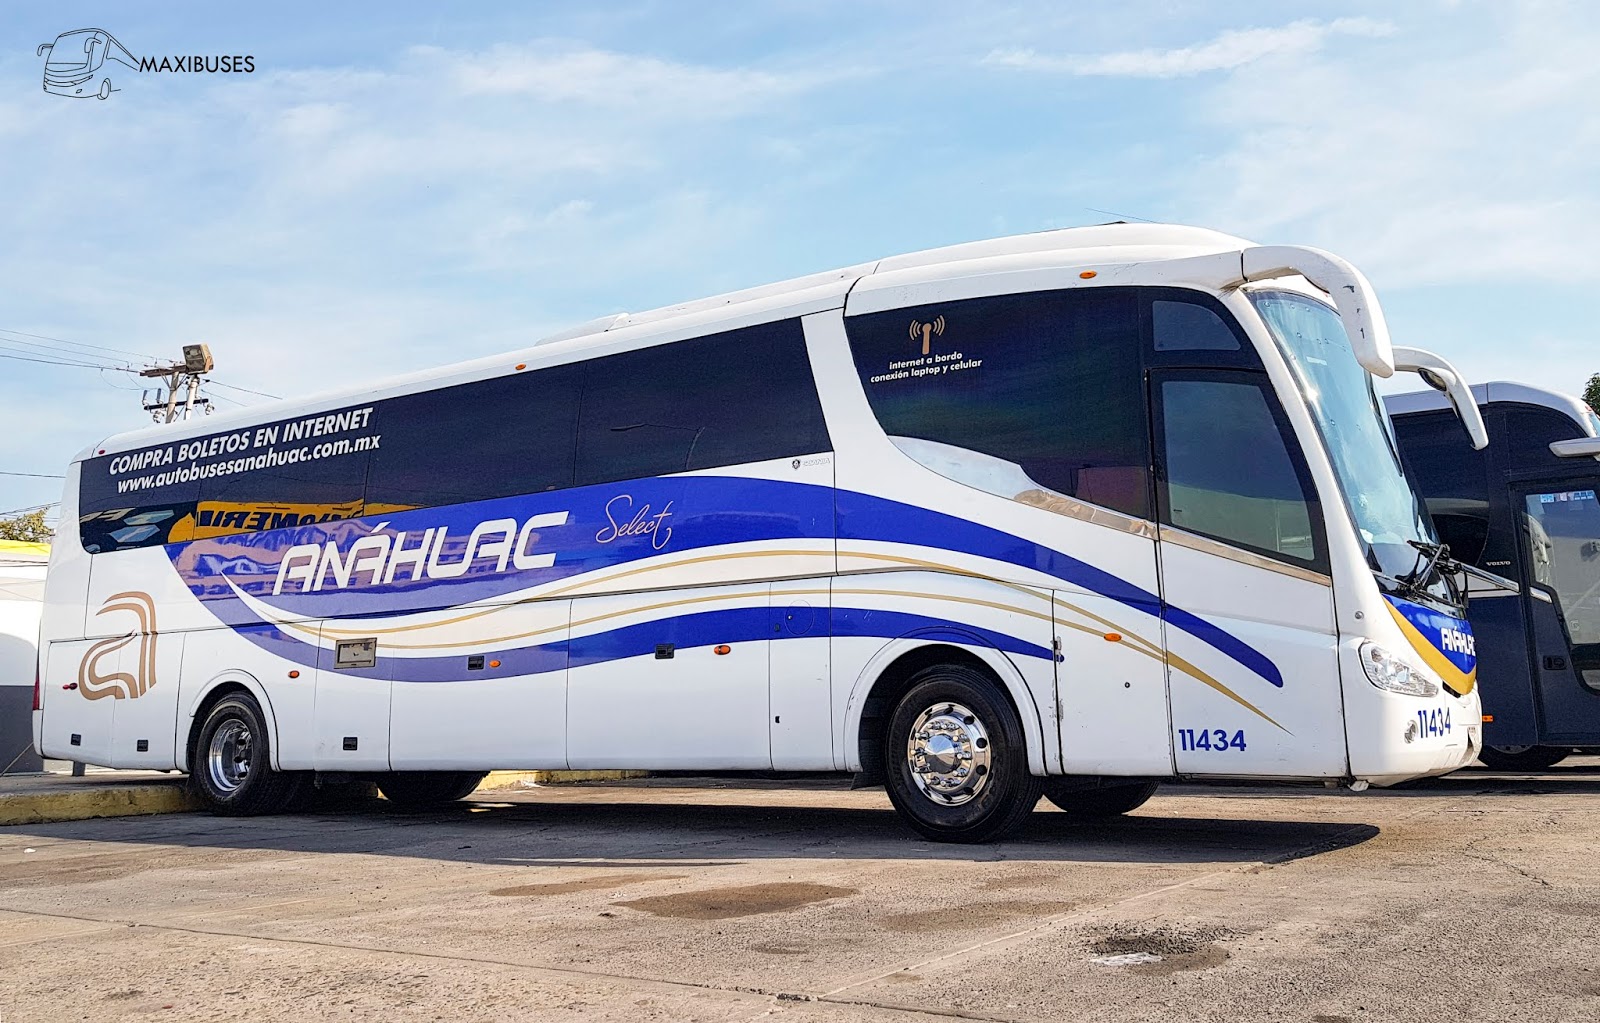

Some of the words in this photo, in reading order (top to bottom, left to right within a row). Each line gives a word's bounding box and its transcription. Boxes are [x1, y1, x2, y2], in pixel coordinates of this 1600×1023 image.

[870, 370, 909, 383] conexión
[911, 366, 941, 377] laptop
[942, 364, 948, 374] y
[950, 359, 983, 371] celular
[889, 358, 925, 370] internet
[926, 356, 933, 364] a
[935, 351, 963, 363] bordo
[109, 447, 173, 475] COMPRA
[177, 431, 251, 463] BOLETOS
[253, 425, 280, 448] EN
[282, 407, 374, 443] INTERNET
[117, 434, 382, 493] www.autobusesanahuac.com.mx
[595, 494, 674, 550] Select
[272, 510, 570, 596] ANÁHUAC
[1178, 728, 1247, 752] 11434
[1417, 706, 1451, 739] 11434
